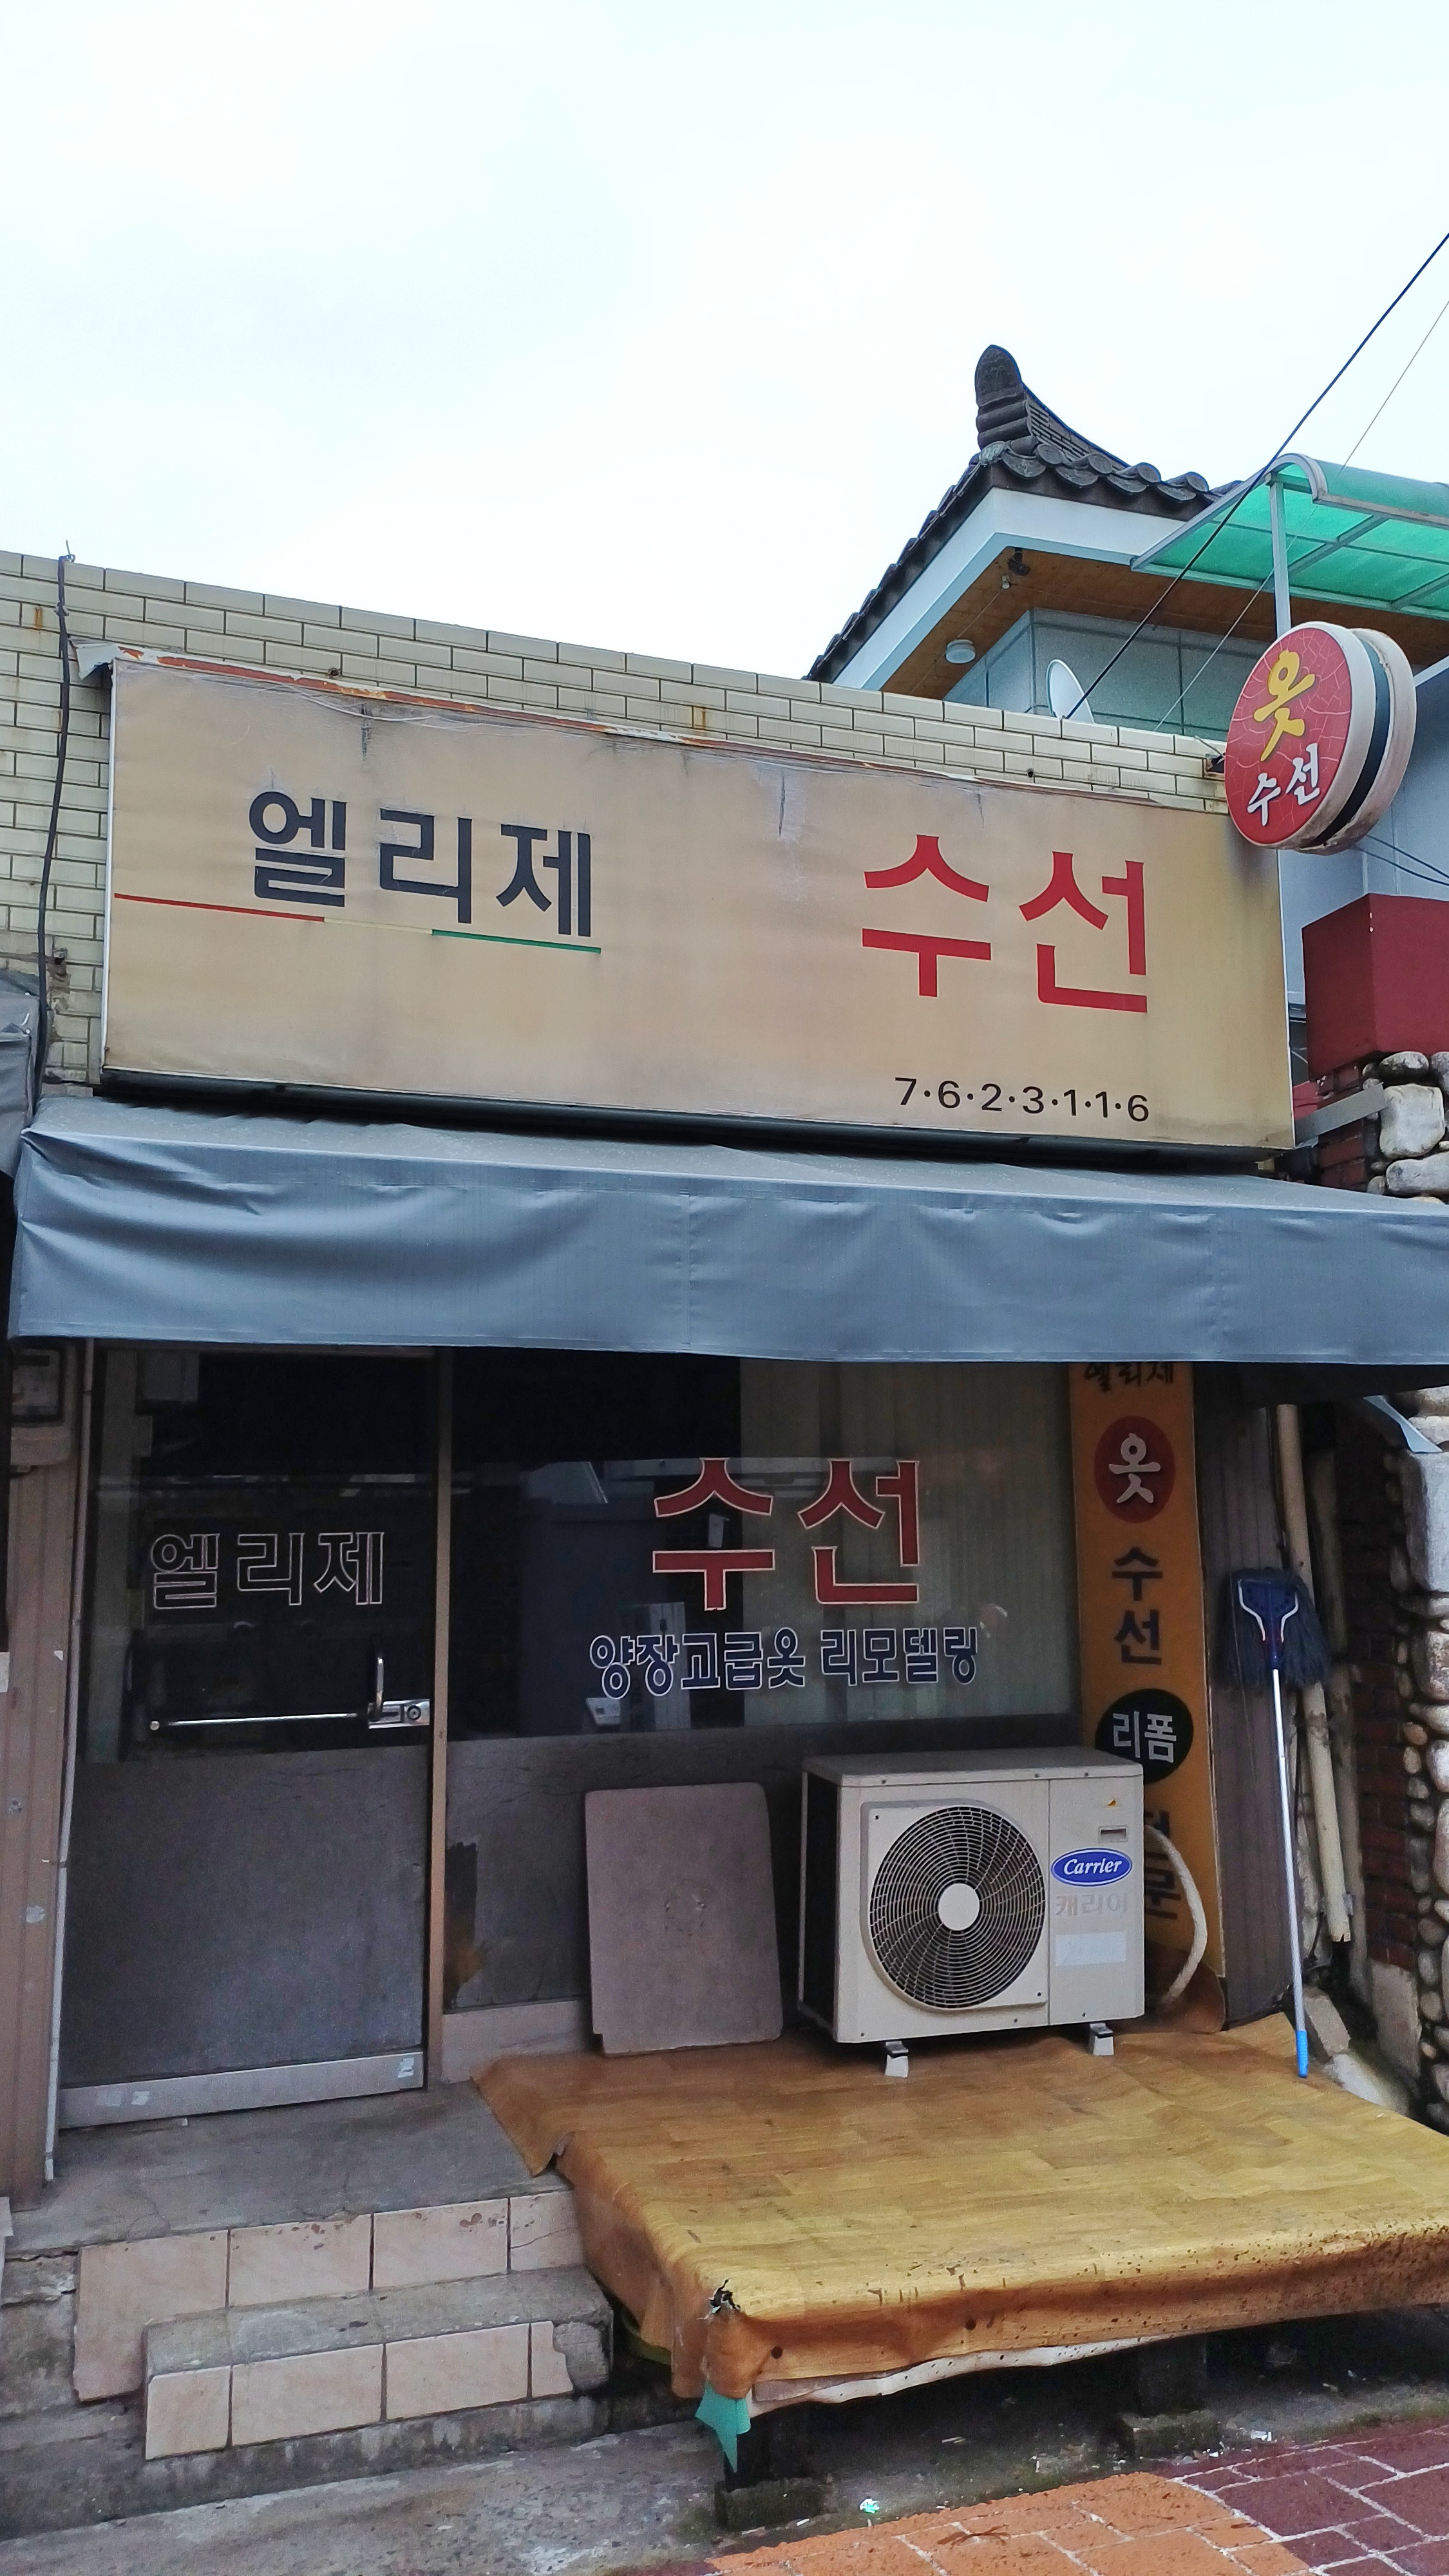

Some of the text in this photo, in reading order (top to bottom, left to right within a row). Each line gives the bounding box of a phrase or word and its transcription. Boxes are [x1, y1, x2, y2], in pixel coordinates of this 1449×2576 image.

[1253, 649, 1316, 762] 옷
[1247, 742, 1320, 828] 수선
[249, 791, 1148, 1013] 엘리제 수선
[1108, 1433, 1161, 1504] 옷
[149, 1531, 385, 1609] 엘리제
[652, 1457, 920, 1611] 수선
[1112, 1546, 1164, 1666] 수선
[589, 1626, 978, 1700] 양장고급옷 리모델링
[1112, 1710, 1177, 1764] 리폼
[1063, 1857, 1122, 1875] Carrier
